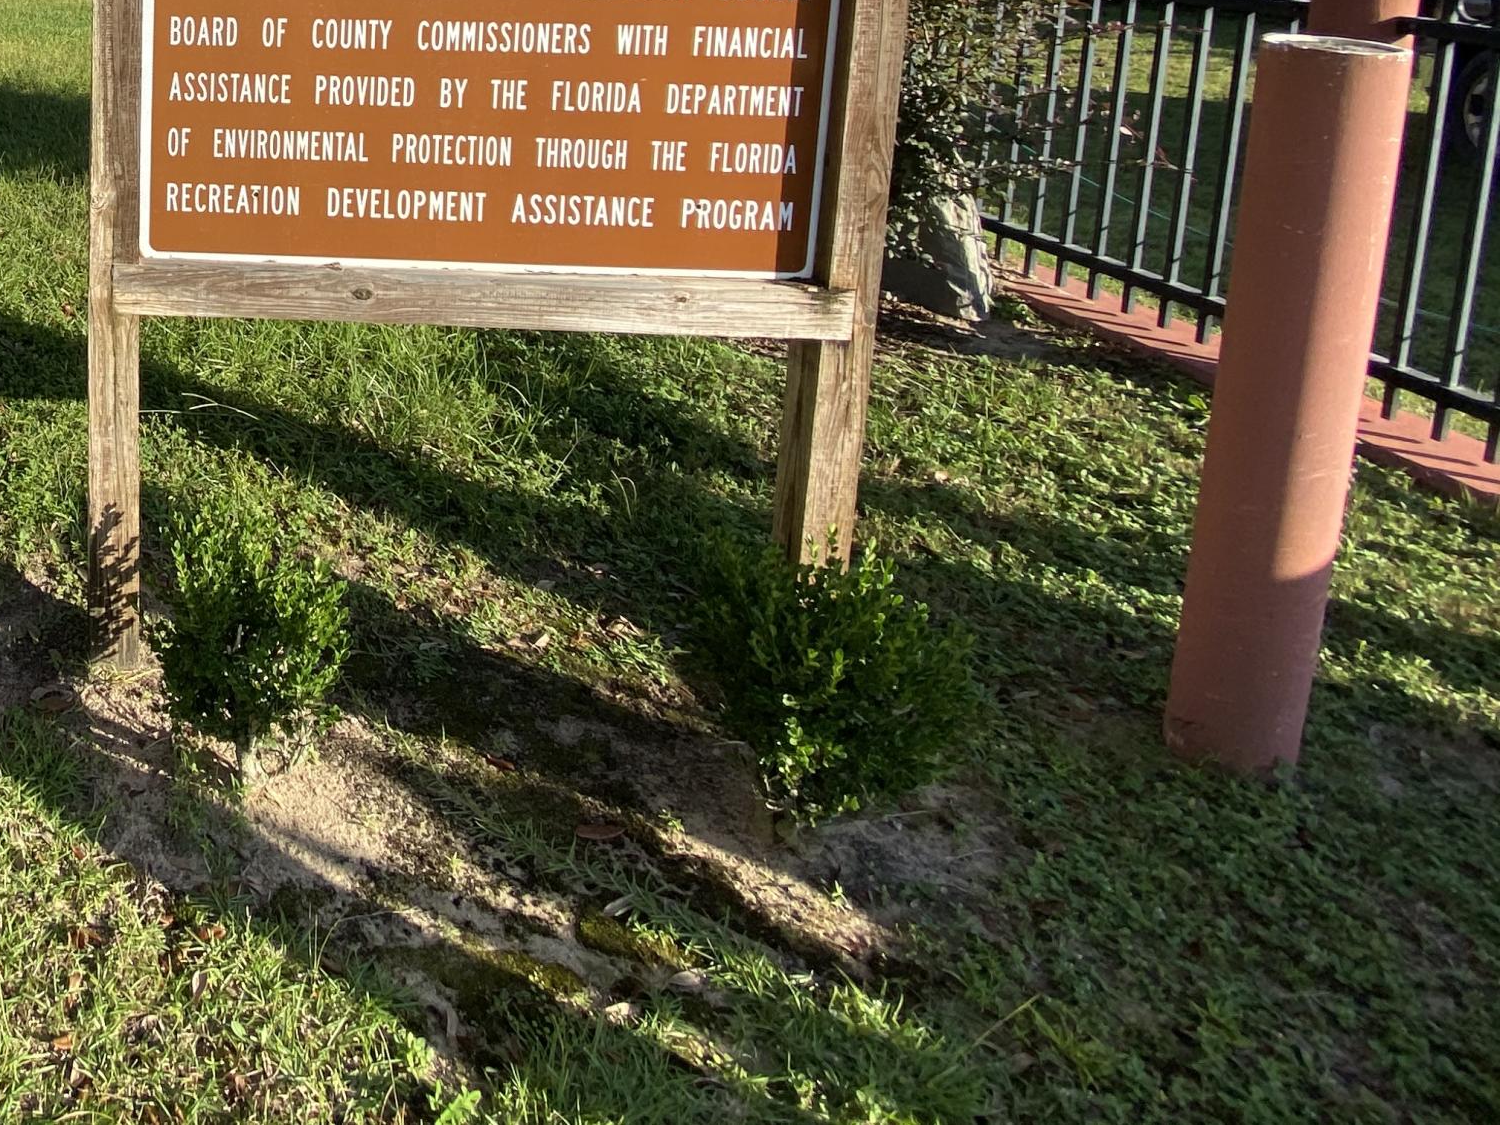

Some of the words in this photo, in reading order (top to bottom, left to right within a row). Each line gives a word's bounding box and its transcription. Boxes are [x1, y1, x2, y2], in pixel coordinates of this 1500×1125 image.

[170, 16, 238, 47] BOARD
[262, 17, 288, 47] OF
[312, 19, 392, 50] COUNTY
[417, 20, 591, 54] COMMISSIONERS
[616, 24, 668, 56] WITH
[692, 26, 808, 59] FINANCIAL
[169, 72, 291, 104] ASSISTANCE
[315, 75, 415, 107] PROVIDED
[439, 78, 468, 108] BY
[491, 79, 528, 110] THE
[551, 80, 641, 113] FLORIDA
[665, 83, 804, 117] DEPARTMENT
[168, 127, 191, 156] OF
[213, 128, 368, 162] ENVIRONMENTAL
[392, 133, 512, 166] PROTECTION
[536, 137, 628, 169] THROUGH
[651, 140, 687, 171] THE
[709, 142, 796, 175] FLORIDA
[165, 182, 300, 215] RECREATION
[327, 187, 486, 222] DEVELOPMENT
[511, 194, 654, 228] ASSISTANCE
[680, 198, 794, 231] PROGRAM
